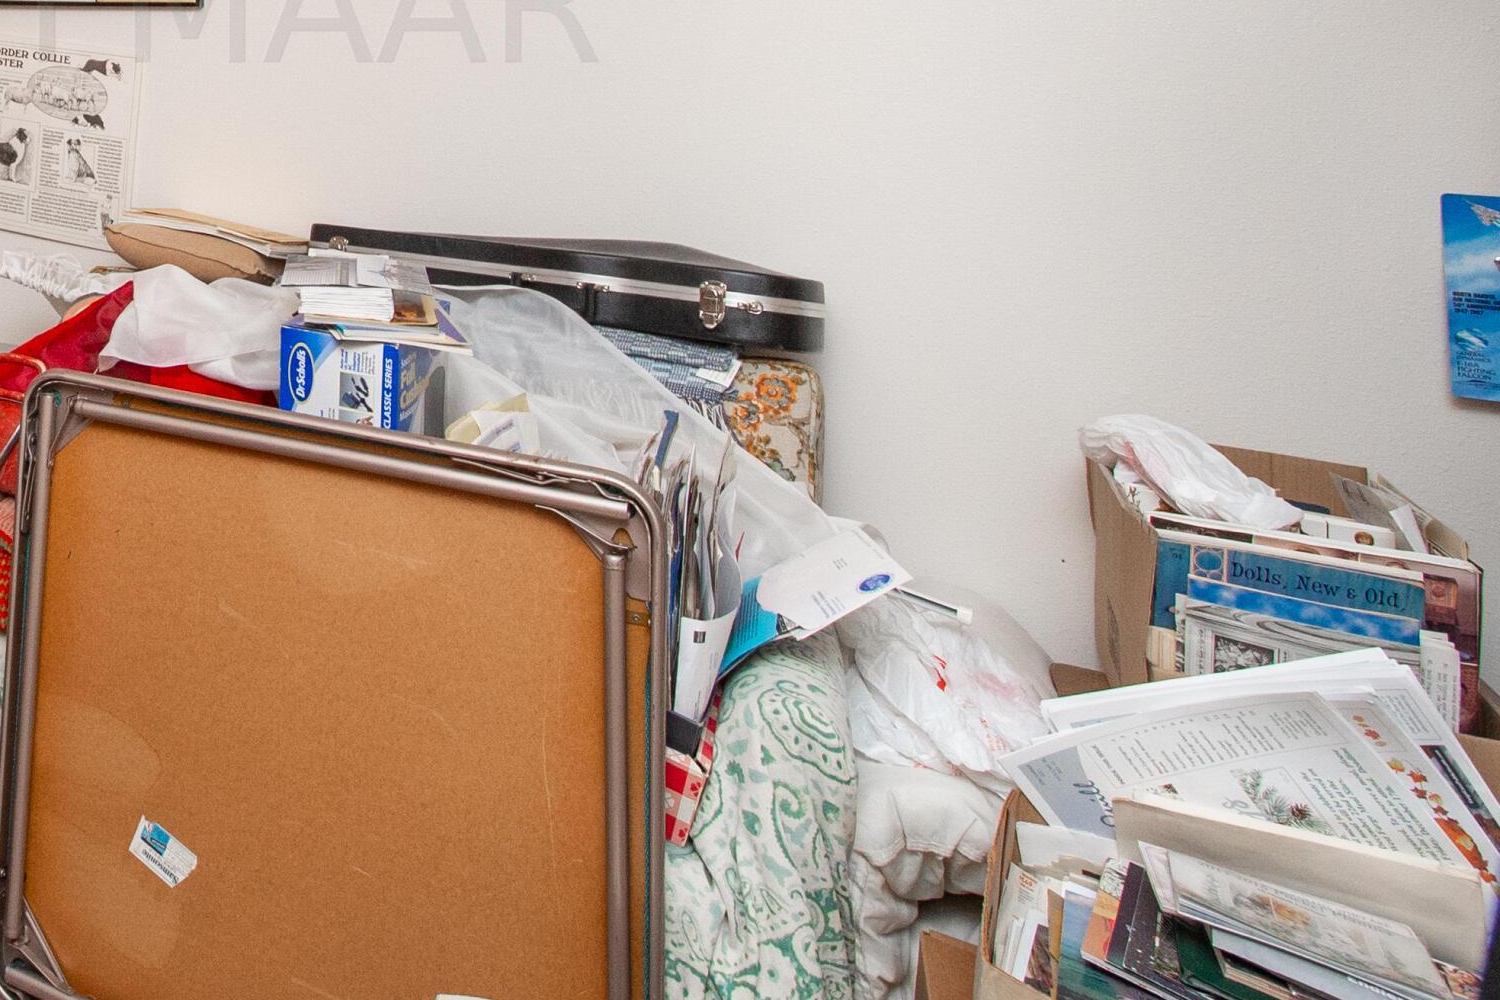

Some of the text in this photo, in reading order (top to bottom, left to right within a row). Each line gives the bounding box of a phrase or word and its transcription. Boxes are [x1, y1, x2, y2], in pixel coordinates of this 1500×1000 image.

[32, 51, 72, 65] COLLIE
[382, 358, 393, 429] CLASSIC SERIES
[1232, 561, 1288, 590] Dolls,
[1296, 574, 1341, 598] New
[1348, 587, 1358, 600] &
[142, 848, 180, 884] Samsonite
